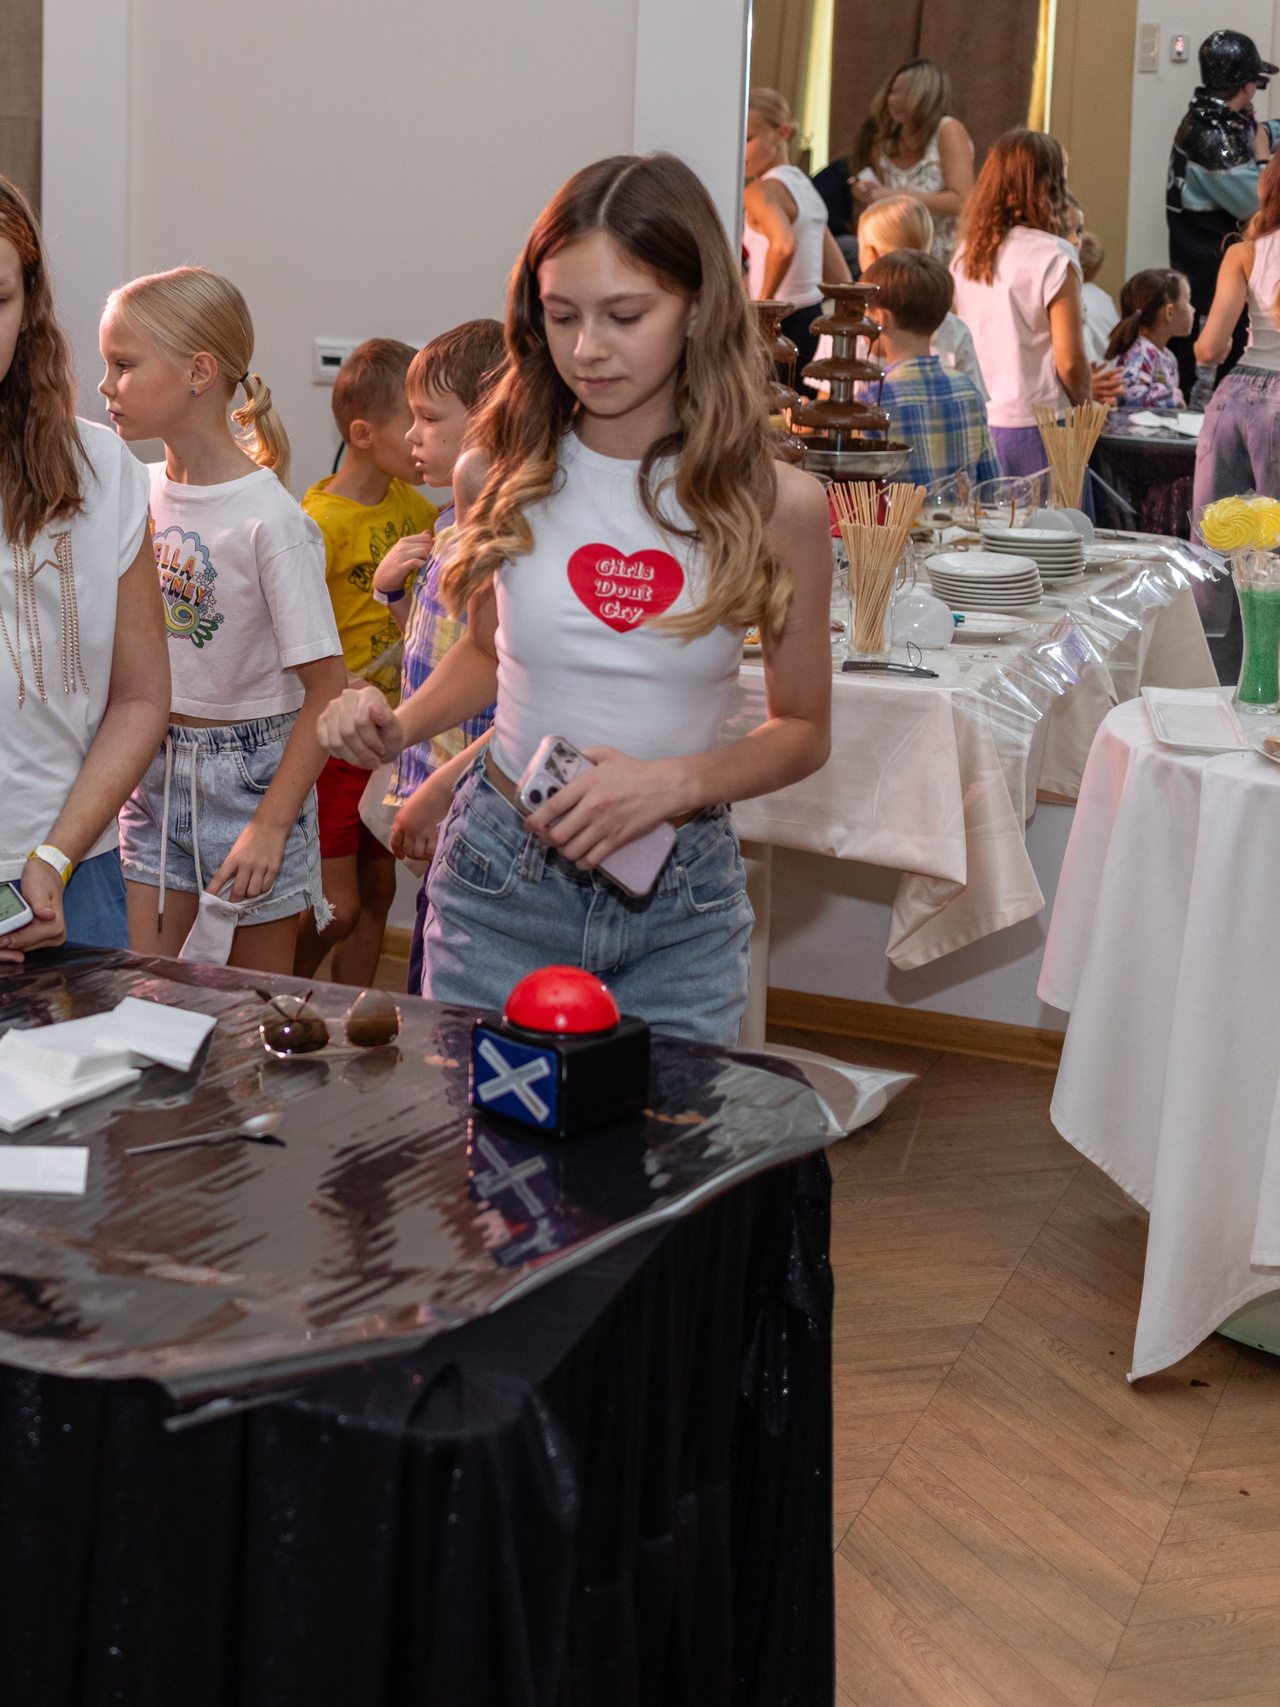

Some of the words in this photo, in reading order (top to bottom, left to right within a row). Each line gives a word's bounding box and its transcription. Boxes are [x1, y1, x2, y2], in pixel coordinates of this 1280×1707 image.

[595, 558, 654, 580] Girls
[158, 570, 208, 606] TNEY
[600, 601, 644, 624] Cry
